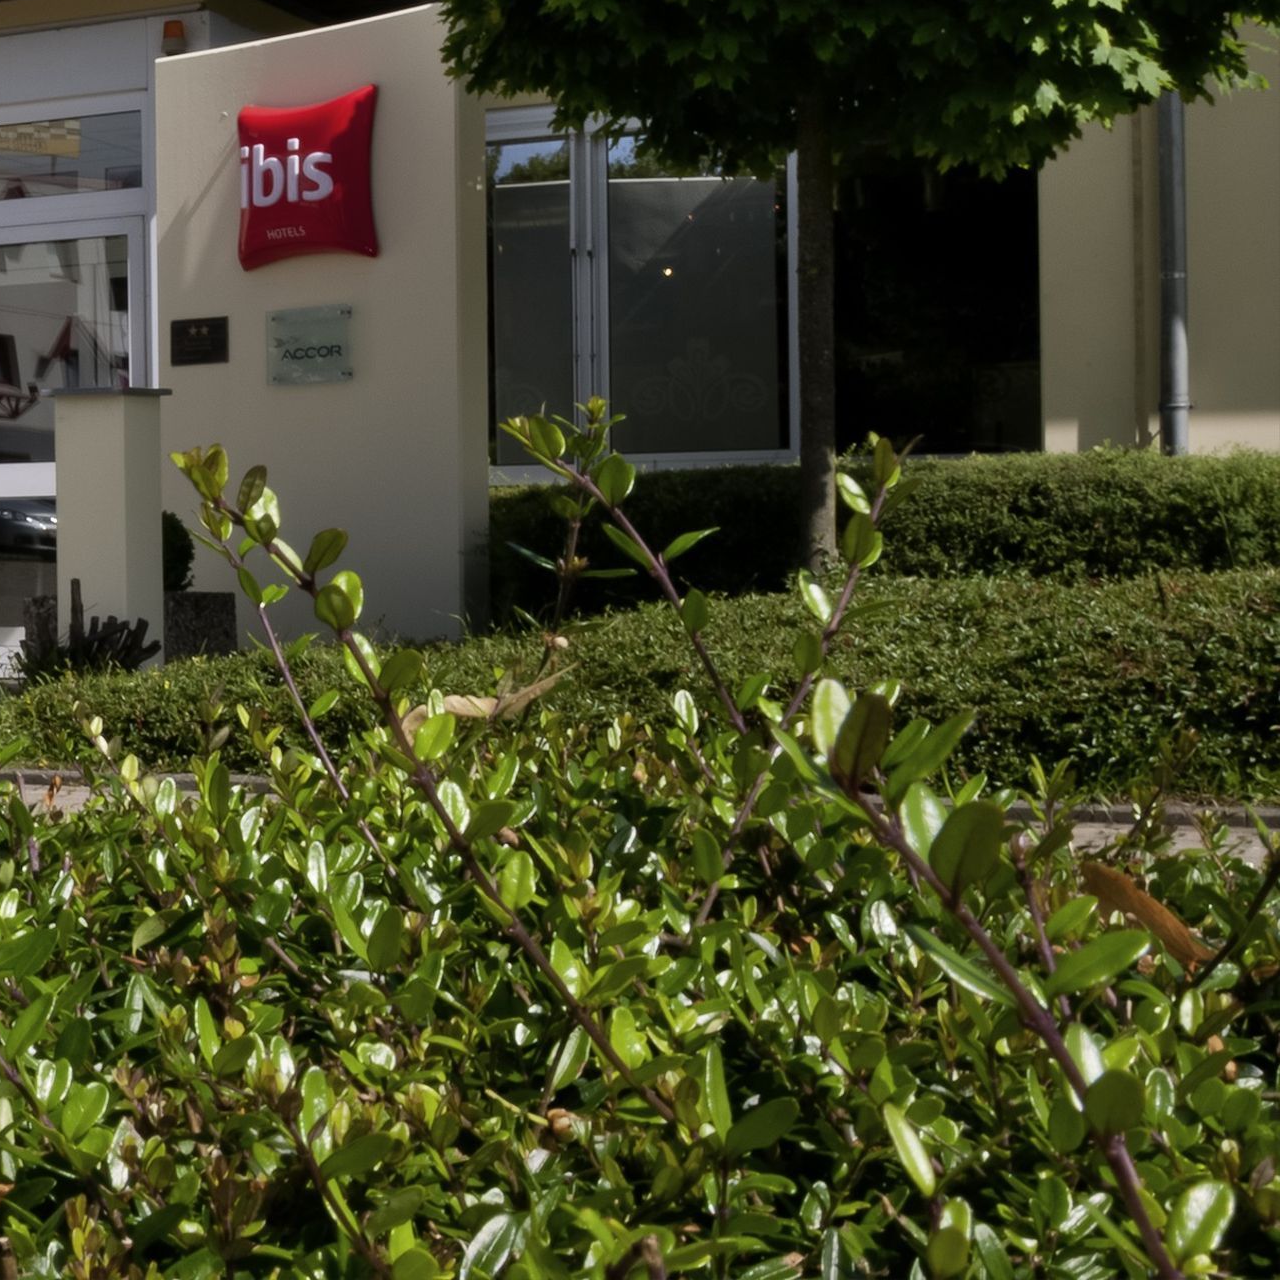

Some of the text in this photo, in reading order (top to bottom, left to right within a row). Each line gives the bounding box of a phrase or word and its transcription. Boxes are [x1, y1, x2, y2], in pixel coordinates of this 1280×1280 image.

[241, 138, 334, 209] ibis
[266, 226, 306, 240] HOTELS
[281, 344, 343, 361] ACCOR
